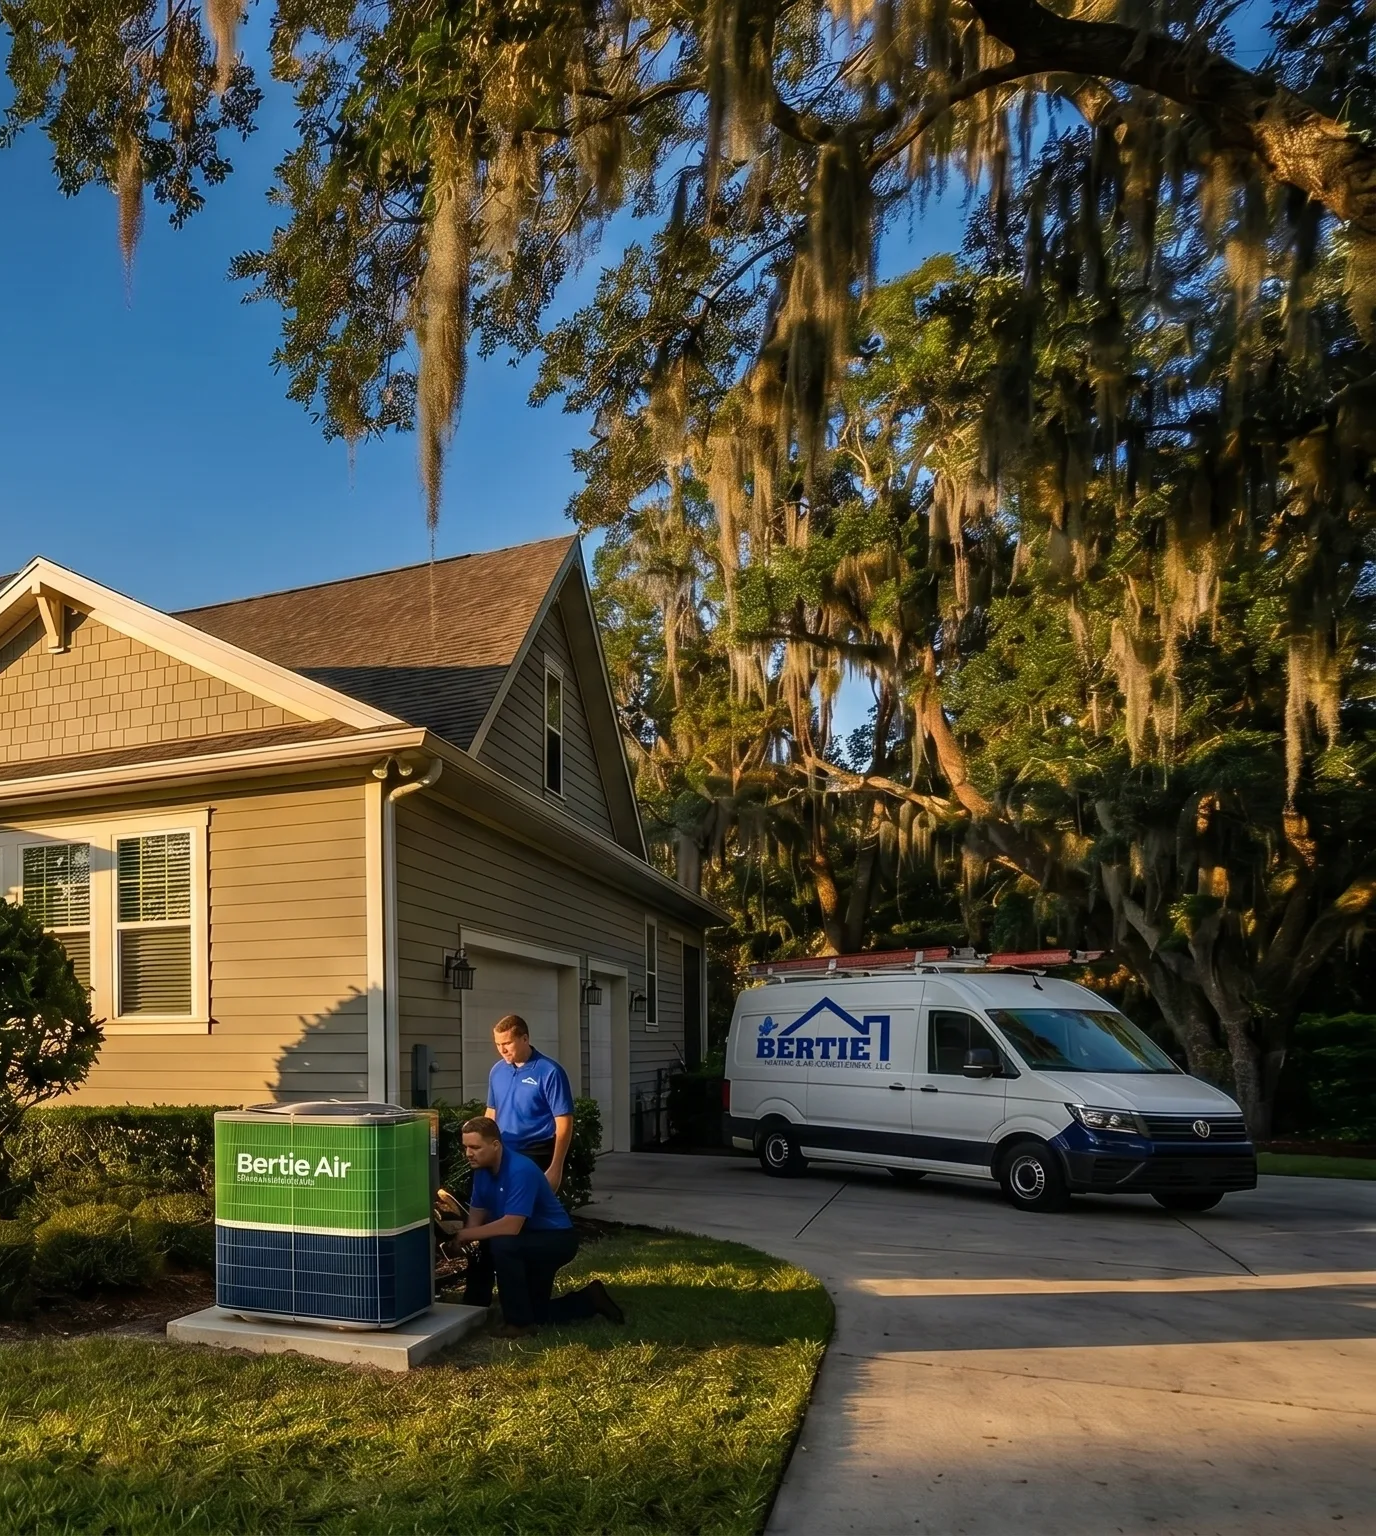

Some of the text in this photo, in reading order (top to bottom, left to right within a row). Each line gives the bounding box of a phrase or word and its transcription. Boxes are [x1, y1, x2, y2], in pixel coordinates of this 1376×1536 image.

[756, 1037, 871, 1060] BERTIE
[237, 1152, 352, 1178] Bertie Air
